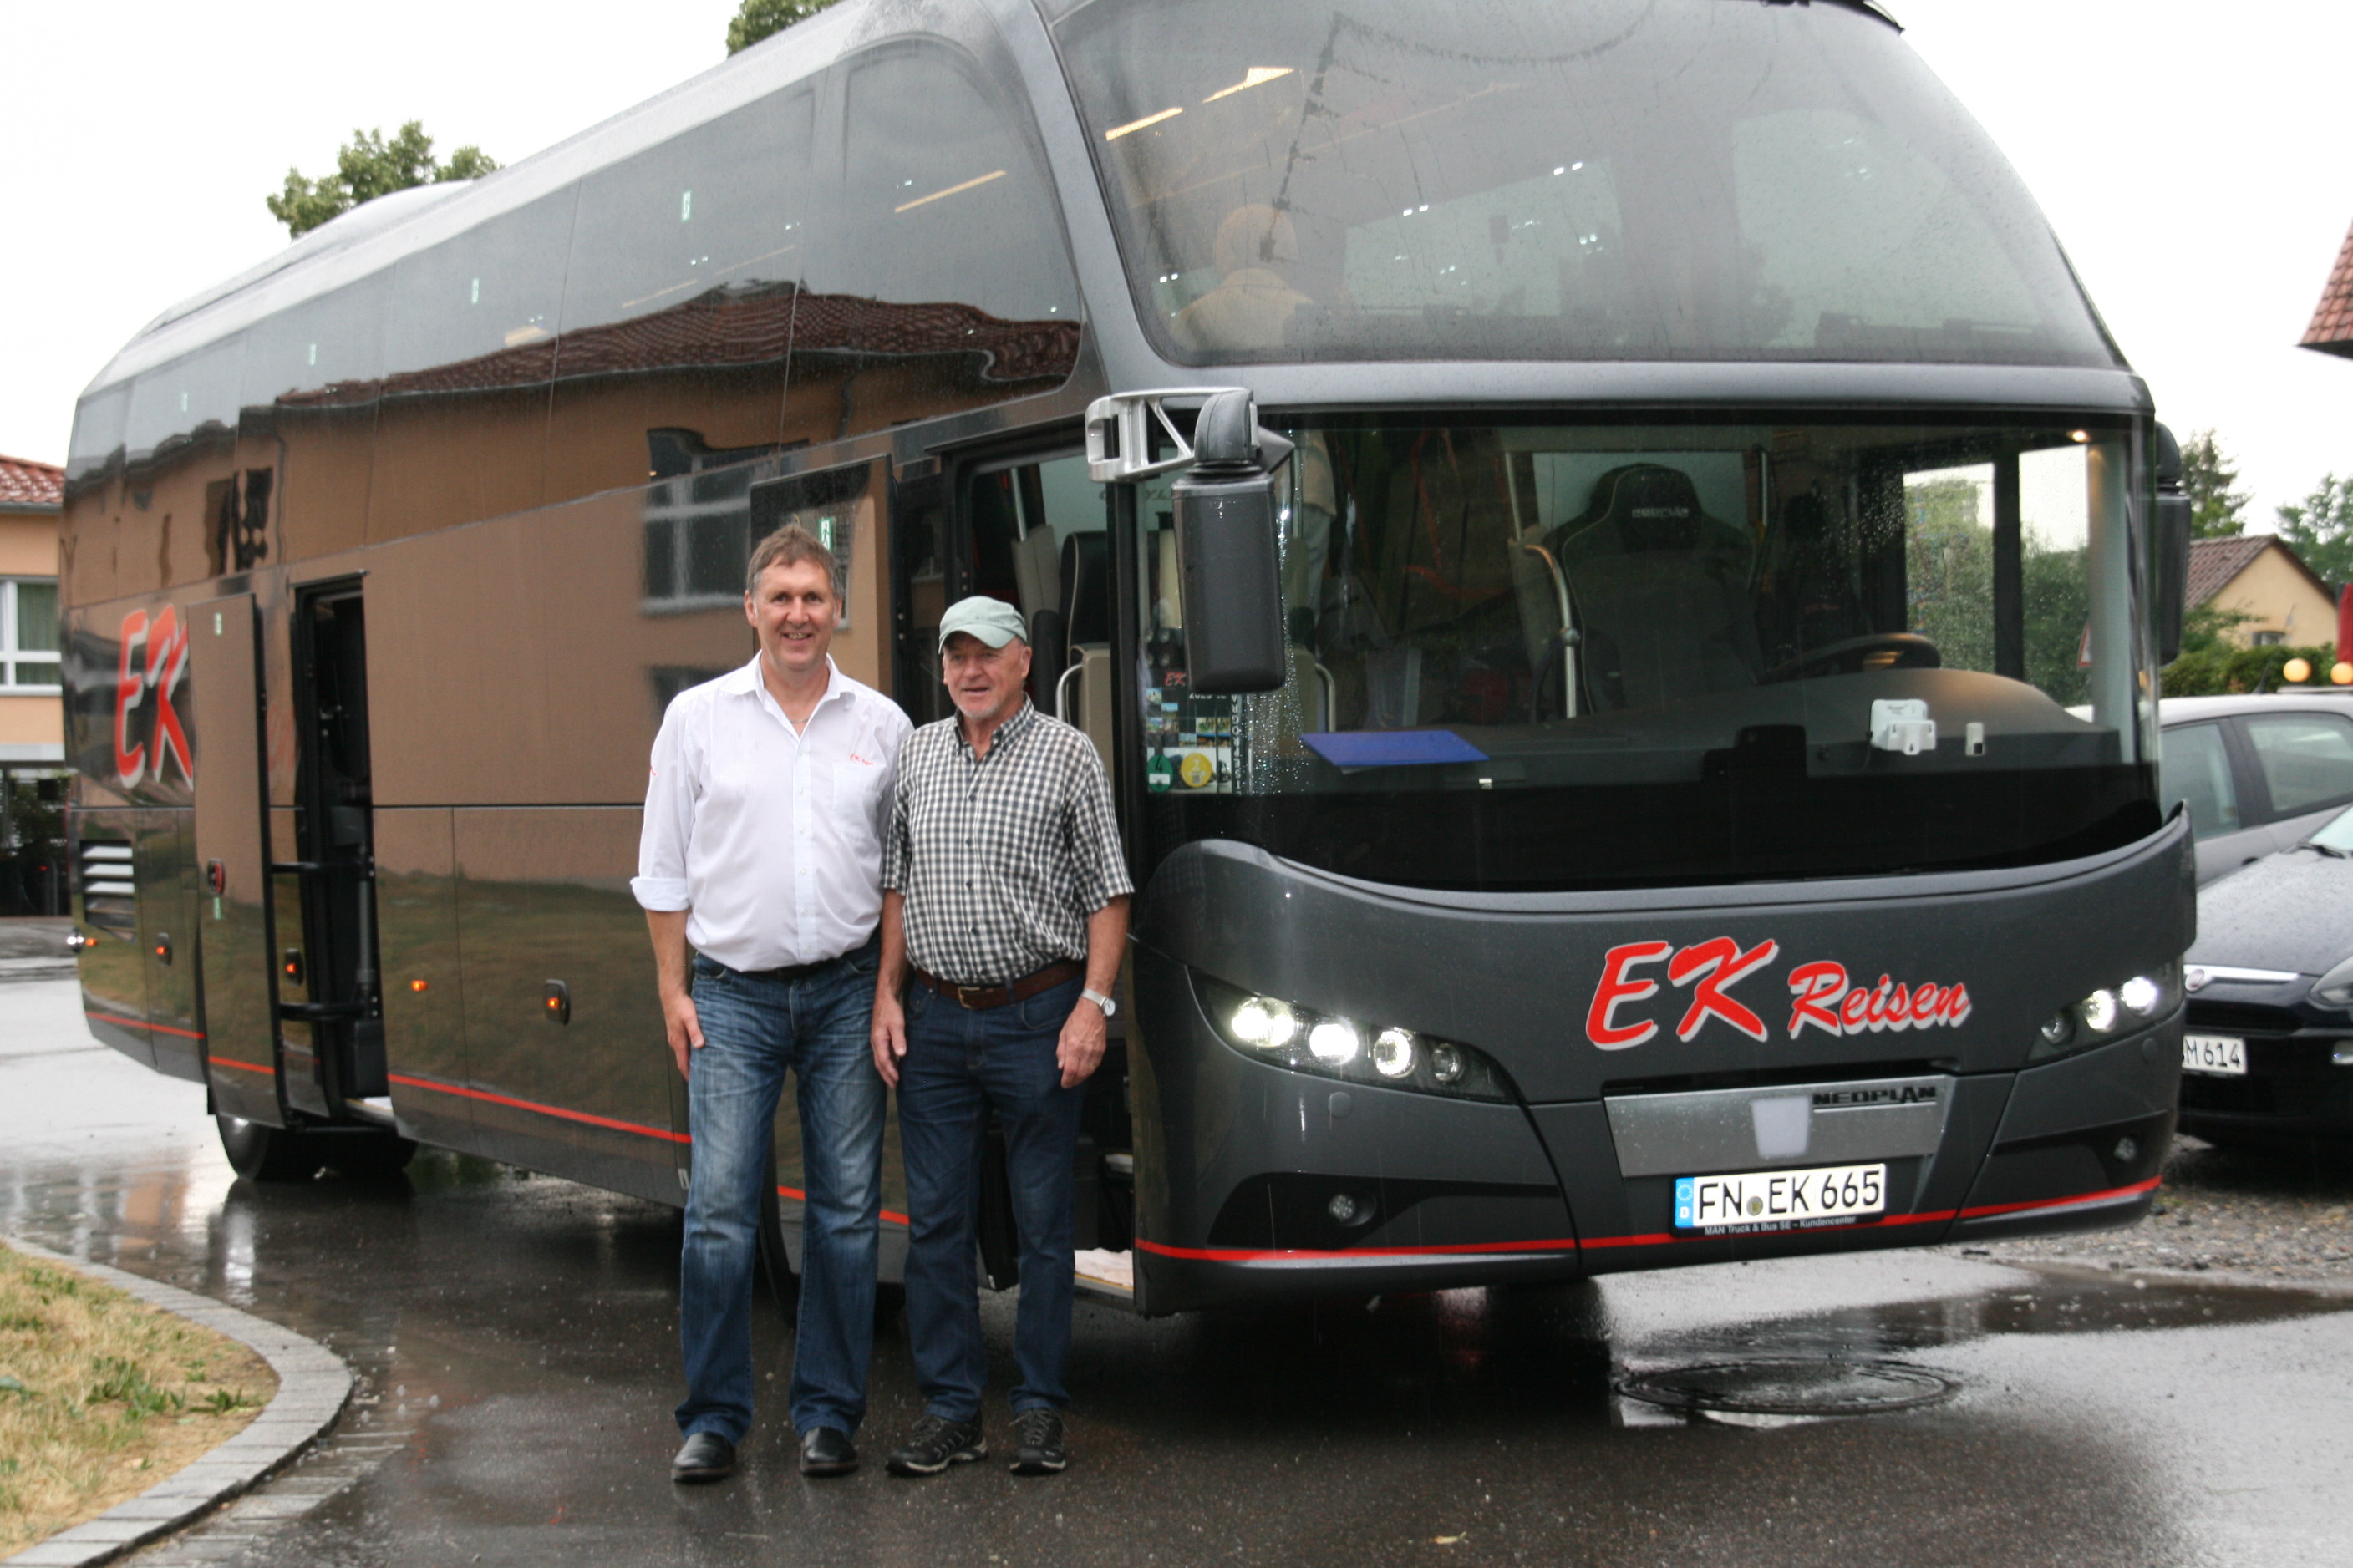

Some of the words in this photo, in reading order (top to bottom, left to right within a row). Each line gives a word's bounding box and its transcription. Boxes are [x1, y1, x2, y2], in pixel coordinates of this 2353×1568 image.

[1164, 671, 1187, 687] EK
[114, 603, 195, 791] EK
[1155, 755, 1164, 773] 4
[1586, 936, 1779, 1050] EK
[1787, 961, 1972, 1040] Reisen
[2182, 1038, 2199, 1066] M
[2203, 1041, 2241, 1068] 614
[1812, 1086, 1936, 1105] NEOPLAN
[1680, 1206, 1690, 1219] D
[1699, 1180, 1742, 1220] FN
[1768, 1175, 1811, 1215] EK
[1821, 1170, 1881, 1210] 665
[1705, 1225, 1725, 1236] MAN
[1728, 1224, 1750, 1234] Truck
[1752, 1223, 1759, 1232] &
[1761, 1222, 1777, 1231] Bus
[1780, 1220, 1791, 1231] SE
[1800, 1215, 1857, 1228] Kundencenter
